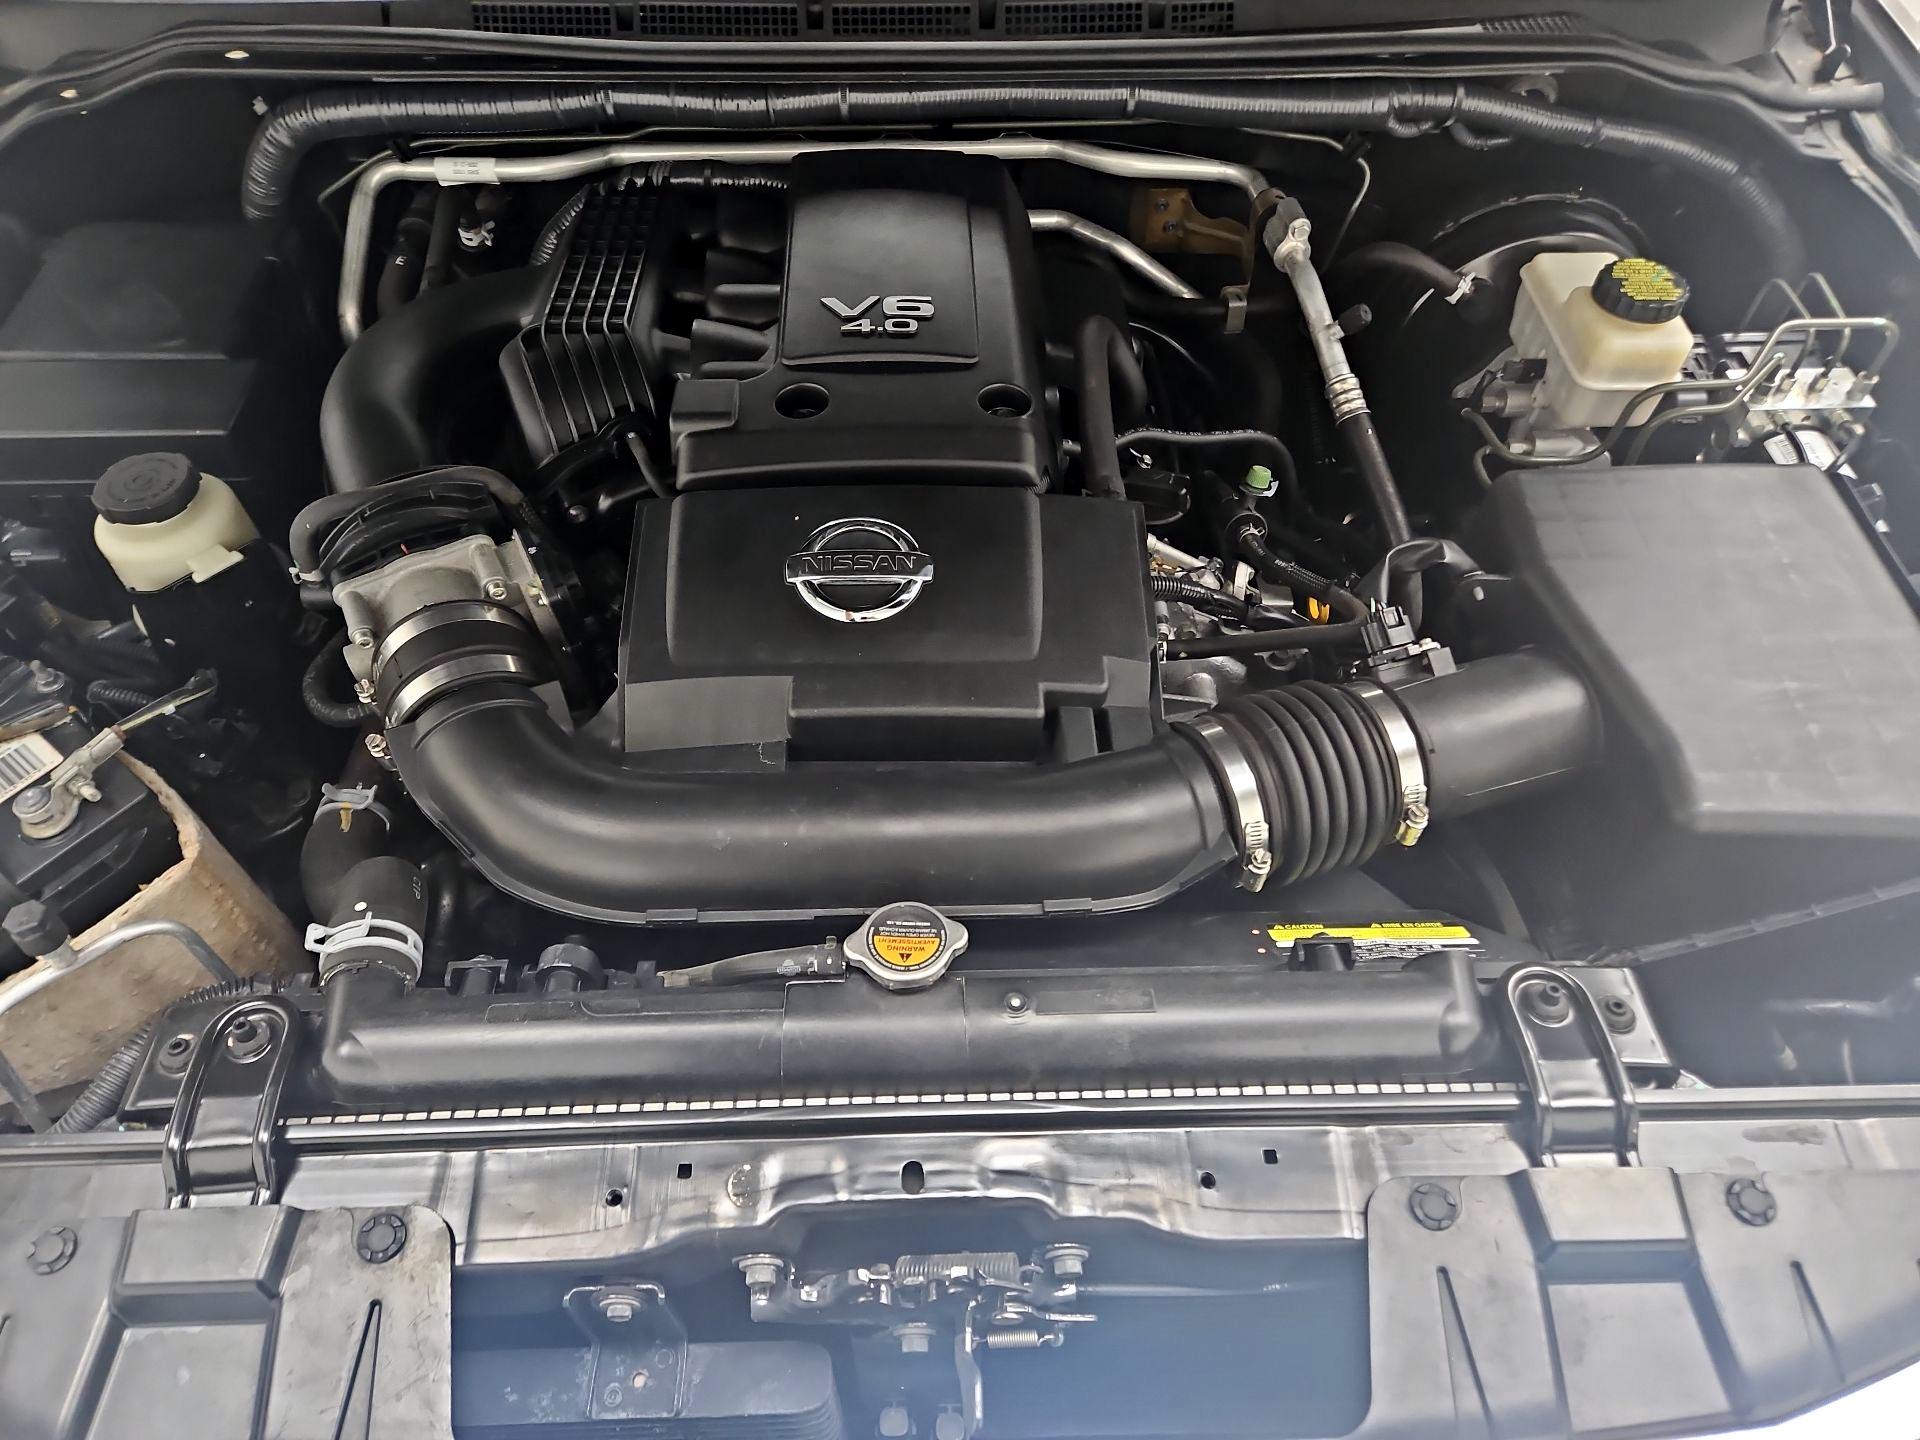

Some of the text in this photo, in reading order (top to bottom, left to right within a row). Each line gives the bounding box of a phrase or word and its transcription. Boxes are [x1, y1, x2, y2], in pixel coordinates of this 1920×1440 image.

[820, 295, 935, 319] V6
[840, 318, 919, 334] 4.0
[802, 554, 916, 571] NISSAN
